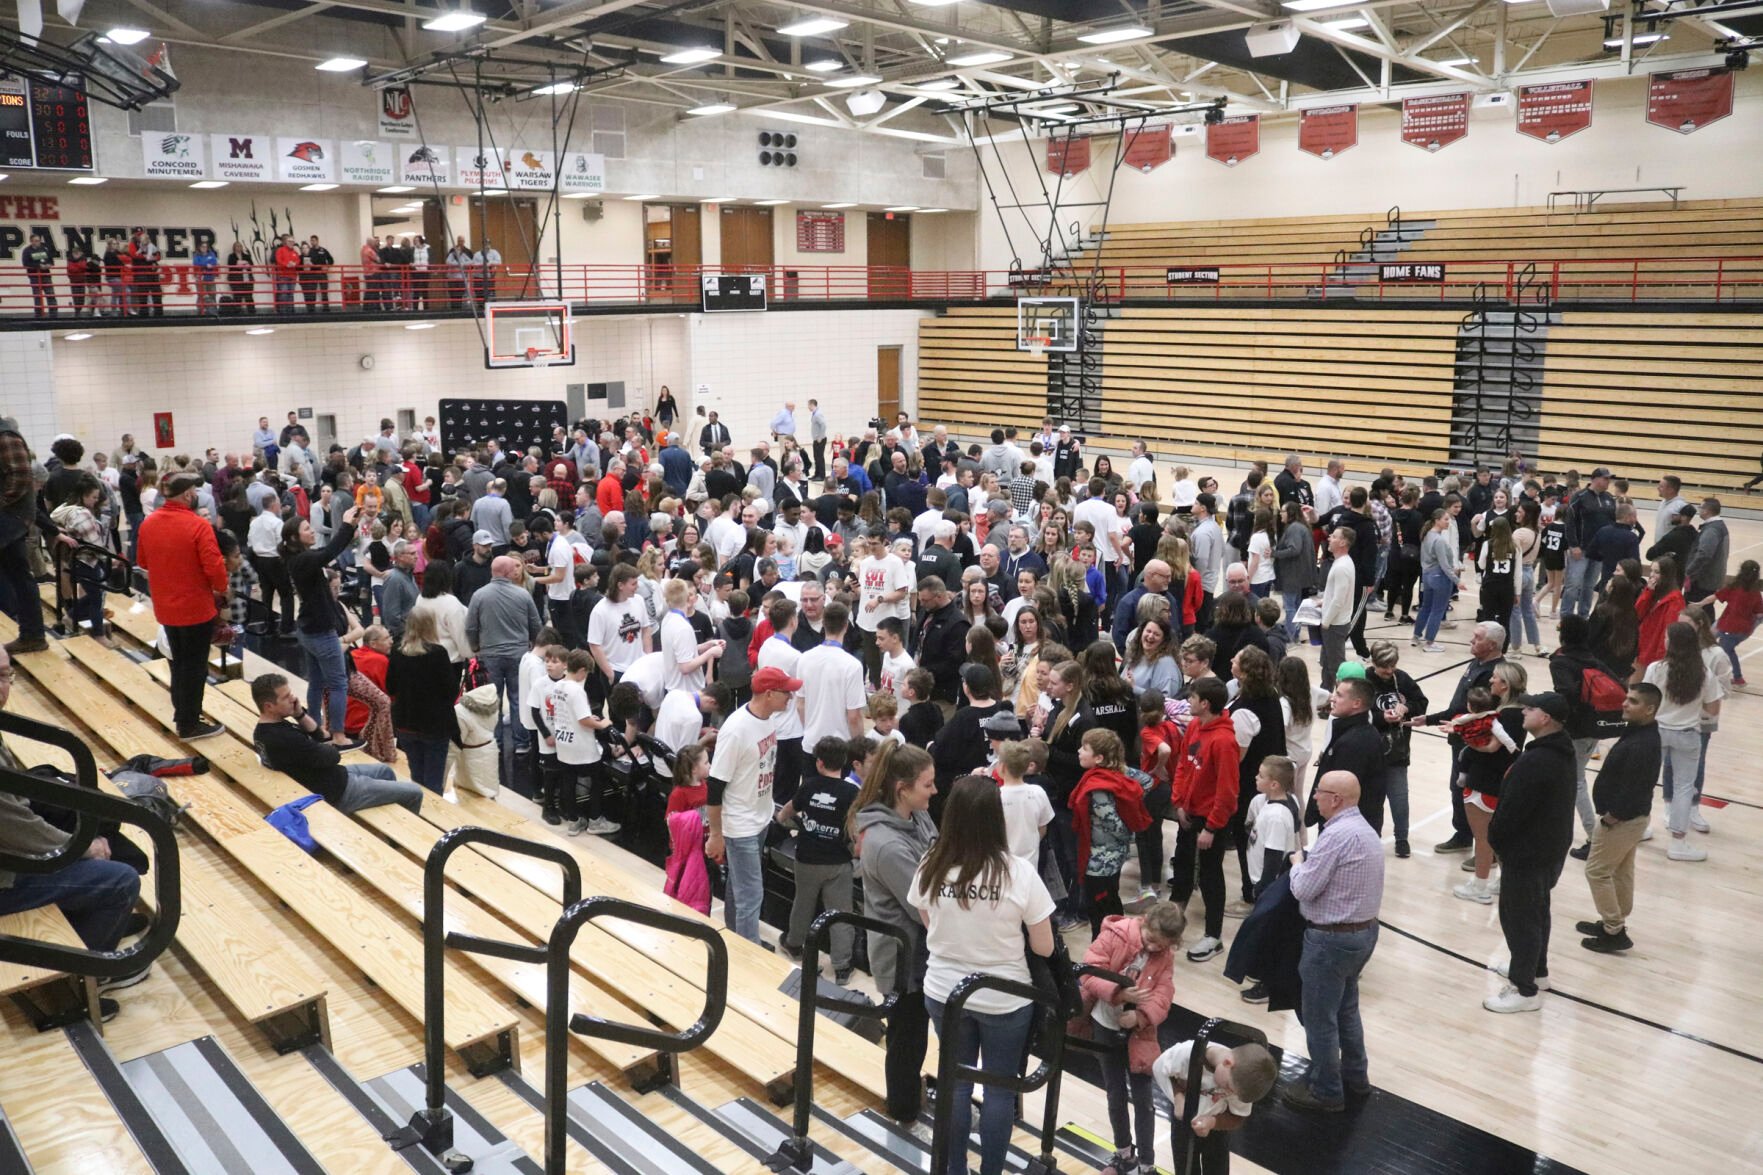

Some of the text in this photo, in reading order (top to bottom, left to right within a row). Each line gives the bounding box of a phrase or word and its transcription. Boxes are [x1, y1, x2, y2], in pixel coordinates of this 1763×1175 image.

[0, 95, 24, 106] IONS
[6, 131, 29, 139] FOULS
[229, 138, 253, 159] M
[9, 159, 32, 167] SCORE
[218, 162, 264, 170] MISHAWAKA
[147, 168, 203, 176] MINUTEMEN
[344, 167, 391, 175] NORTHRIDGE
[515, 171, 552, 179] WARSAW
[520, 179, 548, 187] TIGERS
[0, 195, 60, 220] THE
[1168, 271, 1219, 281] STUDENT SECTION
[1384, 265, 1441, 279] HOME FANS
[1547, 536, 1560, 551] 13
[1492, 559, 1511, 574] 13
[1092, 704, 1126, 716] ARSHALL
[555, 729, 574, 743] TATE
[938, 881, 1000, 901] RASCH
